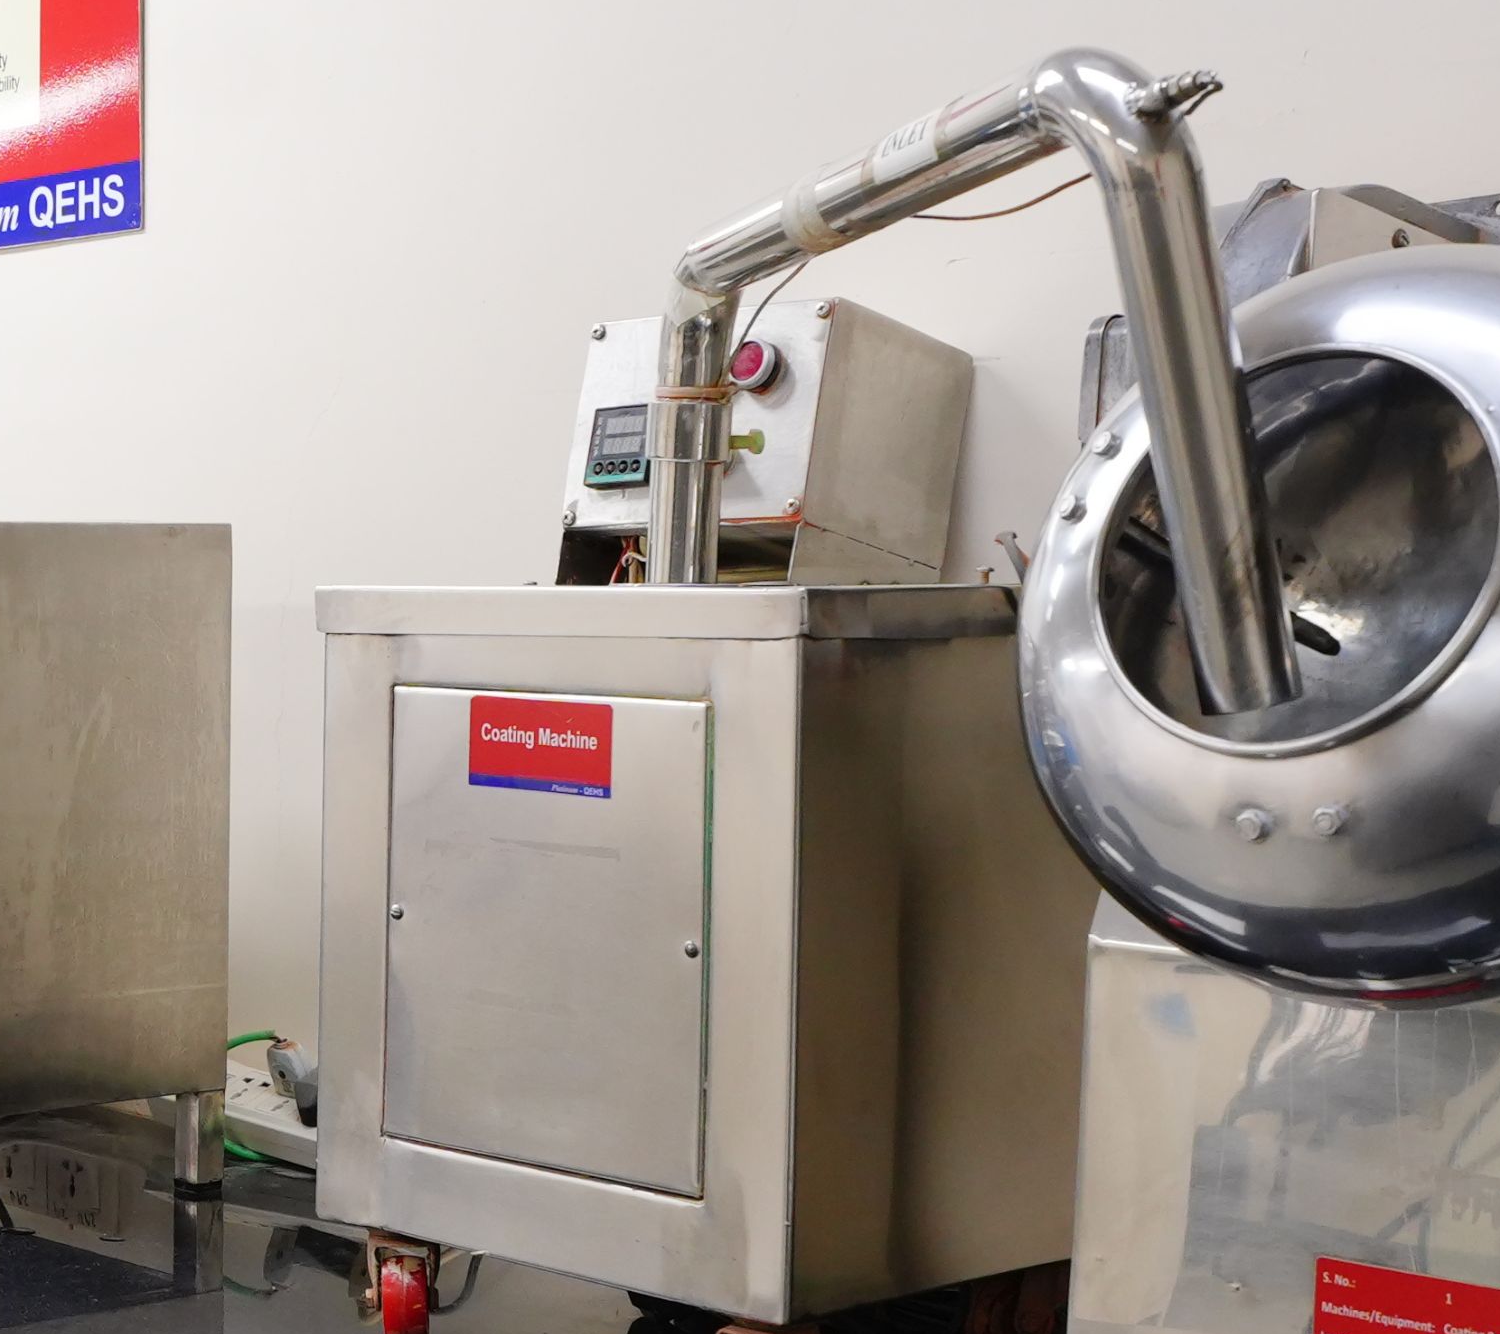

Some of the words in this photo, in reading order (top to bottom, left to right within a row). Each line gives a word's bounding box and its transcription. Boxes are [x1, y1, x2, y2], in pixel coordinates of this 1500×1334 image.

[29, 174, 125, 229] QEHS
[481, 722, 534, 749] Coating
[538, 728, 598, 750] Machine
[1322, 1271, 1333, 1284] S.
[1334, 1274, 1356, 1288] No.:
[1446, 1293, 1452, 1305] 1
[1321, 1301, 1436, 1334] Machines/Equipment:
